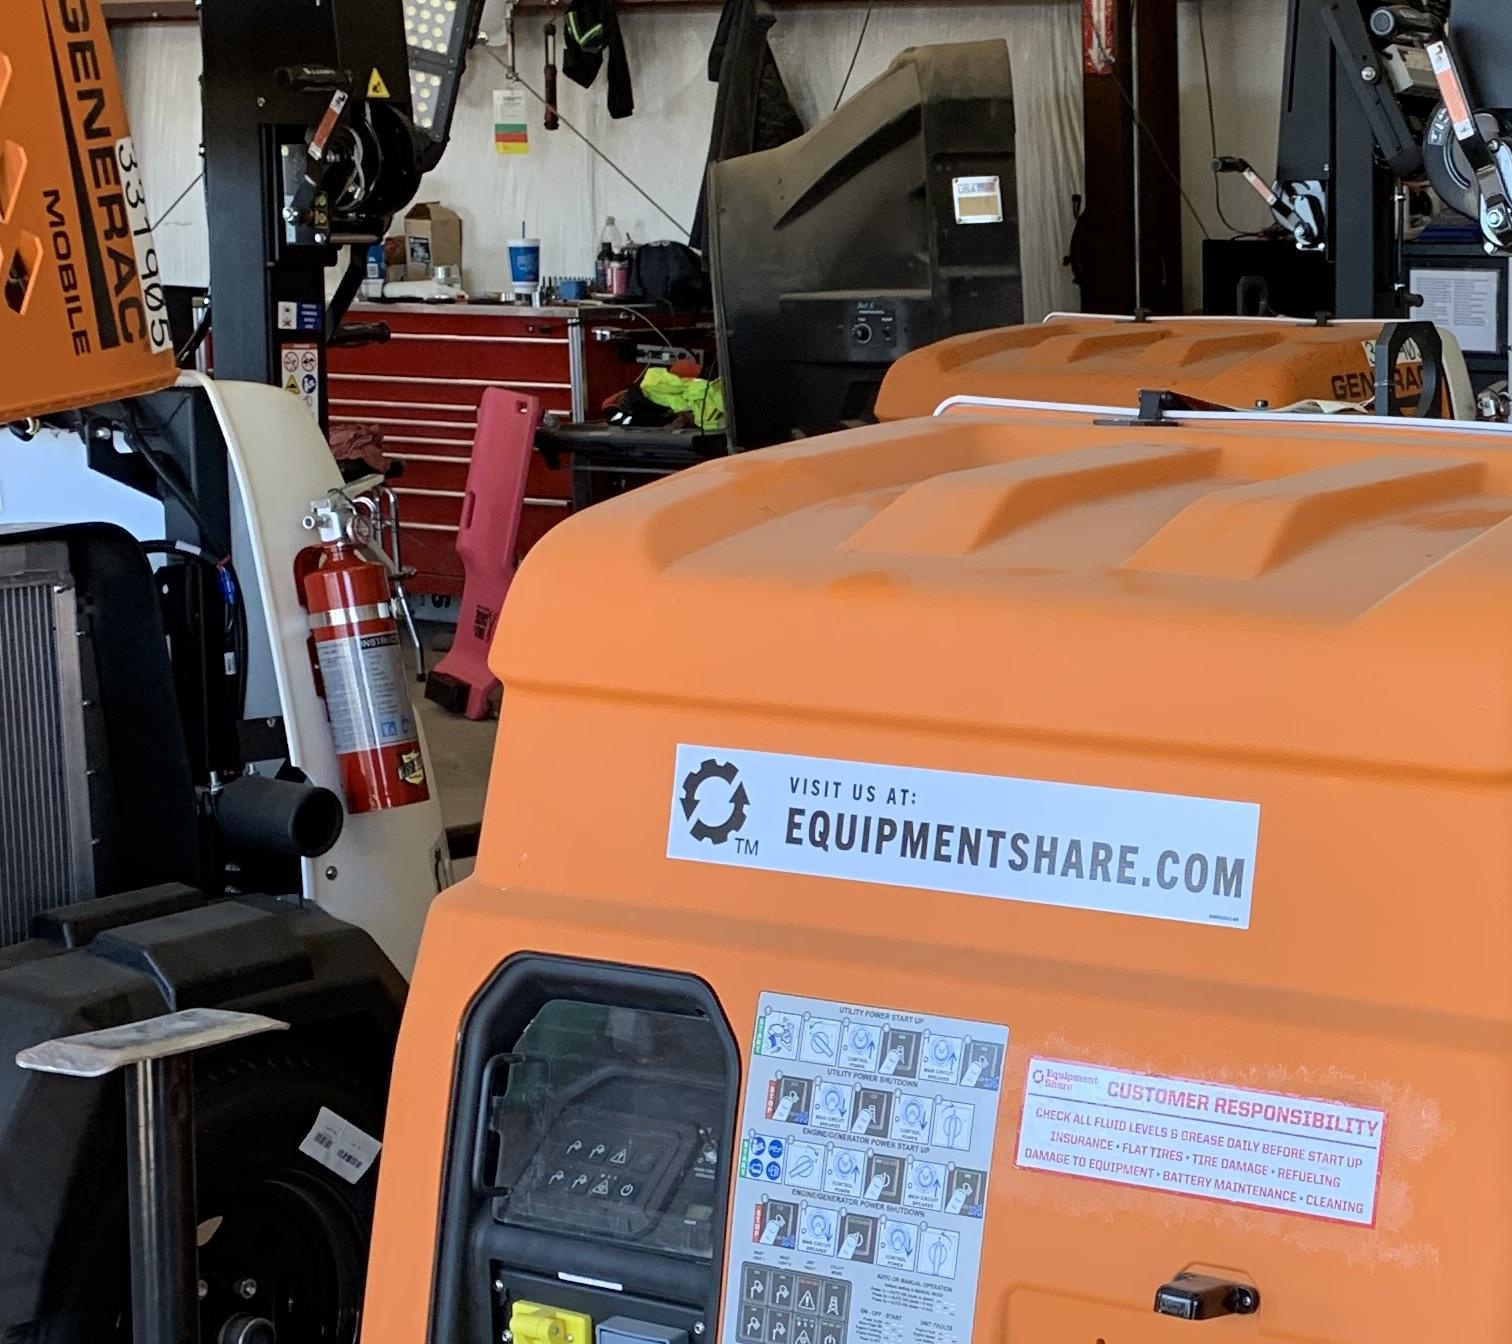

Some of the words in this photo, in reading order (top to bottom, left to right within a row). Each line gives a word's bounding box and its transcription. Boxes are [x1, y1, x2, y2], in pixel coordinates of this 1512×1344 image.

[43, 189, 92, 355] MOBILE
[789, 776, 842, 799] VISIT
[852, 781, 876, 803] US
[886, 785, 918, 806] AT:
[734, 837, 760, 856] TM
[784, 806, 1247, 899] EQUIPMENTSHARE.COM
[864, 1010, 888, 1020] POWER
[888, 1013, 914, 1024] START
[852, 1072, 877, 1083] POWER
[1044, 1078, 1073, 1091] Share
[1046, 1068, 1099, 1085] Equipment
[1107, 1081, 1210, 1112] CUSTOMER
[1214, 1097, 1379, 1138] RESPONSIBILITY
[865, 1138, 889, 1150] POWER
[889, 1143, 916, 1154] START
[1035, 1107, 1071, 1124] CHECK
[1073, 1113, 1092, 1127] ALL
[1094, 1116, 1127, 1132] FLUID
[1129, 1121, 1168, 1139] LEVELS
[1181, 1130, 1225, 1149] GREASE
[1226, 1136, 1260, 1153] DAILY
[1262, 1143, 1305, 1162] BEFORE
[1308, 1150, 1344, 1168] START
[1347, 1156, 1363, 1169] UP
[1050, 1131, 1114, 1152] INSURANCE
[1122, 1143, 1148, 1157] FLAT
[1150, 1146, 1184, 1162] TIRES
[1192, 1153, 1218, 1167] TIRE
[1221, 1157, 1269, 1176] DAMAGE
[1277, 1167, 1341, 1189] REFUELING
[1024, 1147, 1070, 1166] DAMAGE
[1073, 1154, 1086, 1167] TO
[1089, 1158, 1155, 1179] EQUIPMENT
[1163, 1170, 1212, 1189] BATTERY
[1214, 1179, 1298, 1204] MAINTENANCE
[1306, 1193, 1364, 1215] CLEANING
[859, 1201, 885, 1212] POWER
